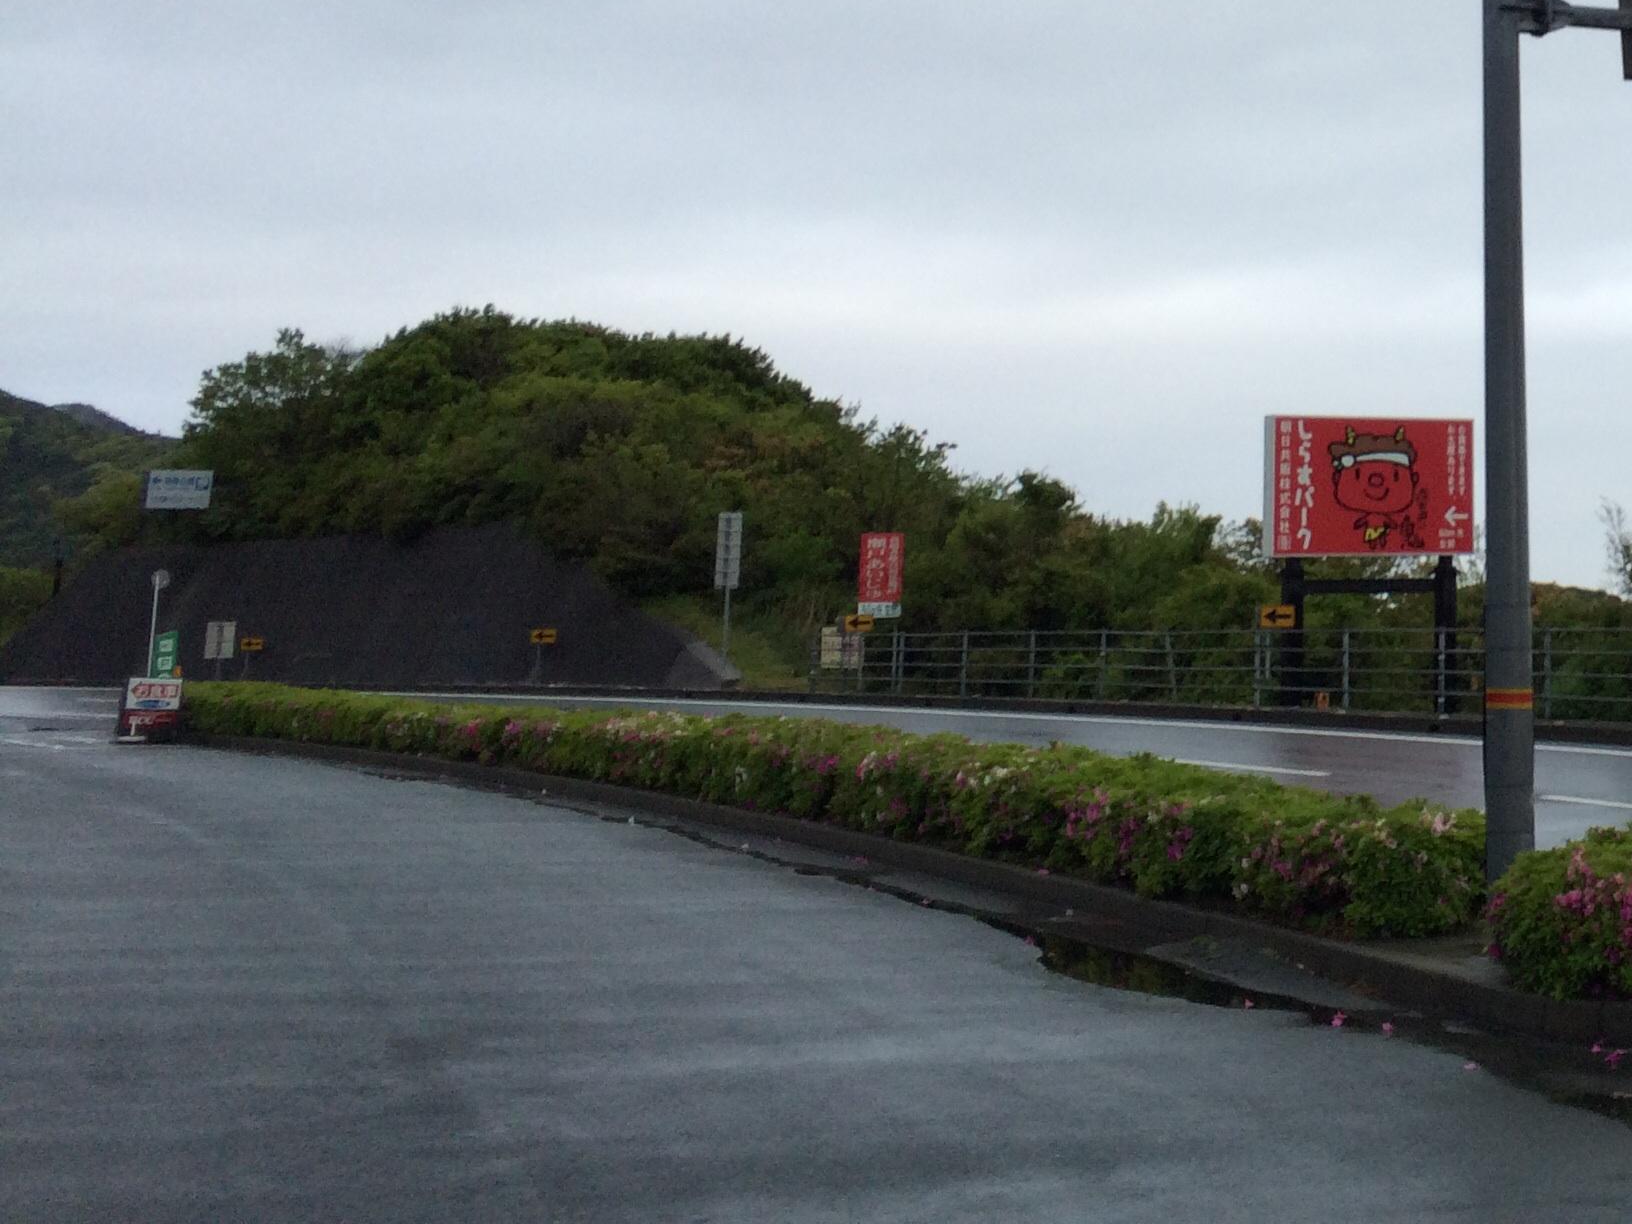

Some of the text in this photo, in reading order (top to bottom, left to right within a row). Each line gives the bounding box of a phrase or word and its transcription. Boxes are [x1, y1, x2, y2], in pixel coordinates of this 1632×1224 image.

[1294, 419, 1315, 550] しらすパーク
